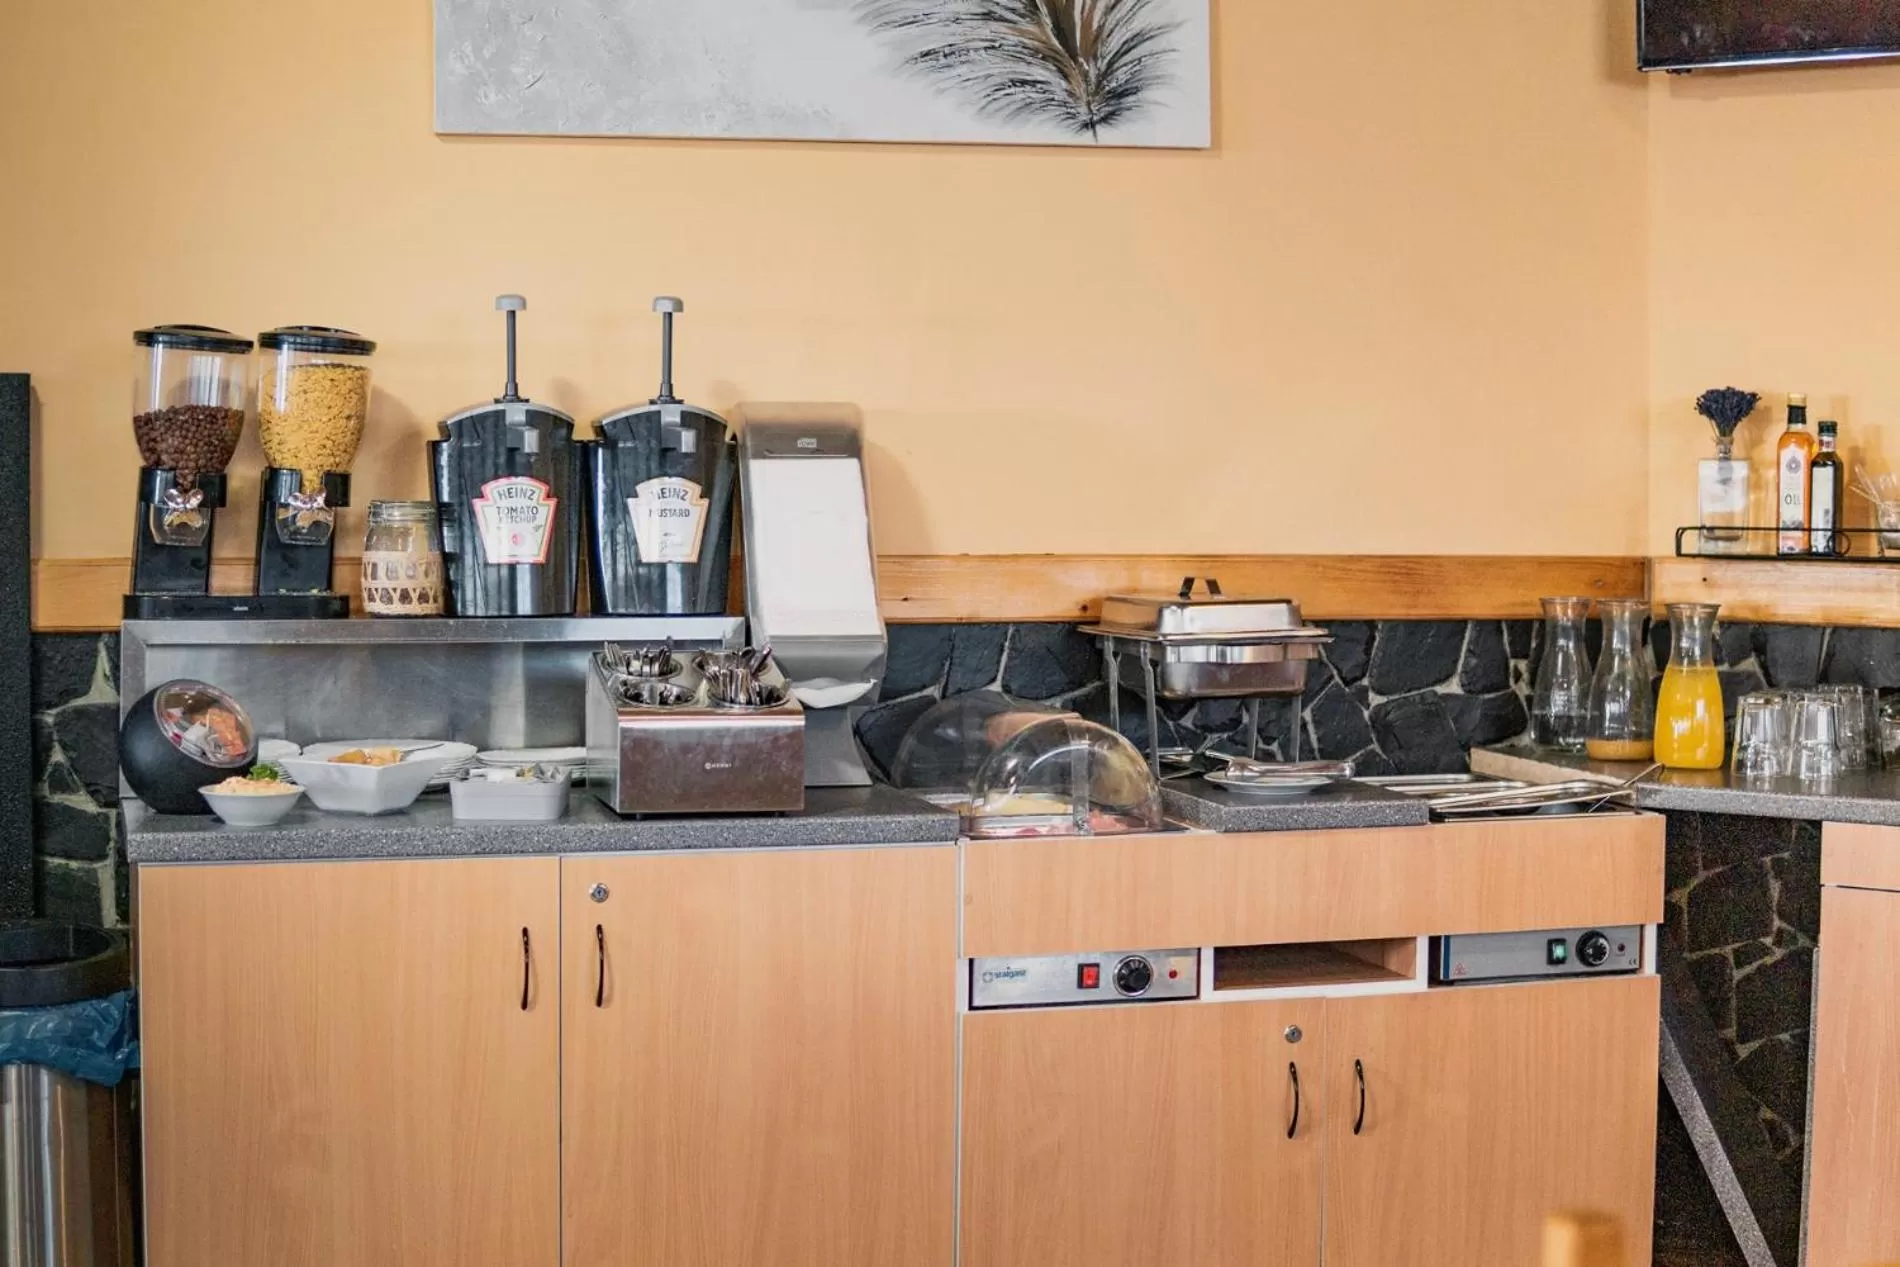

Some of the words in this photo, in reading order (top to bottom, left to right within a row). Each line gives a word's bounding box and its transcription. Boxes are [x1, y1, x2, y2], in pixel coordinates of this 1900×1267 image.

[497, 487, 536, 501] HEINZ
[496, 506, 539, 515] TOMATO
[497, 515, 537, 524] TCHUP
